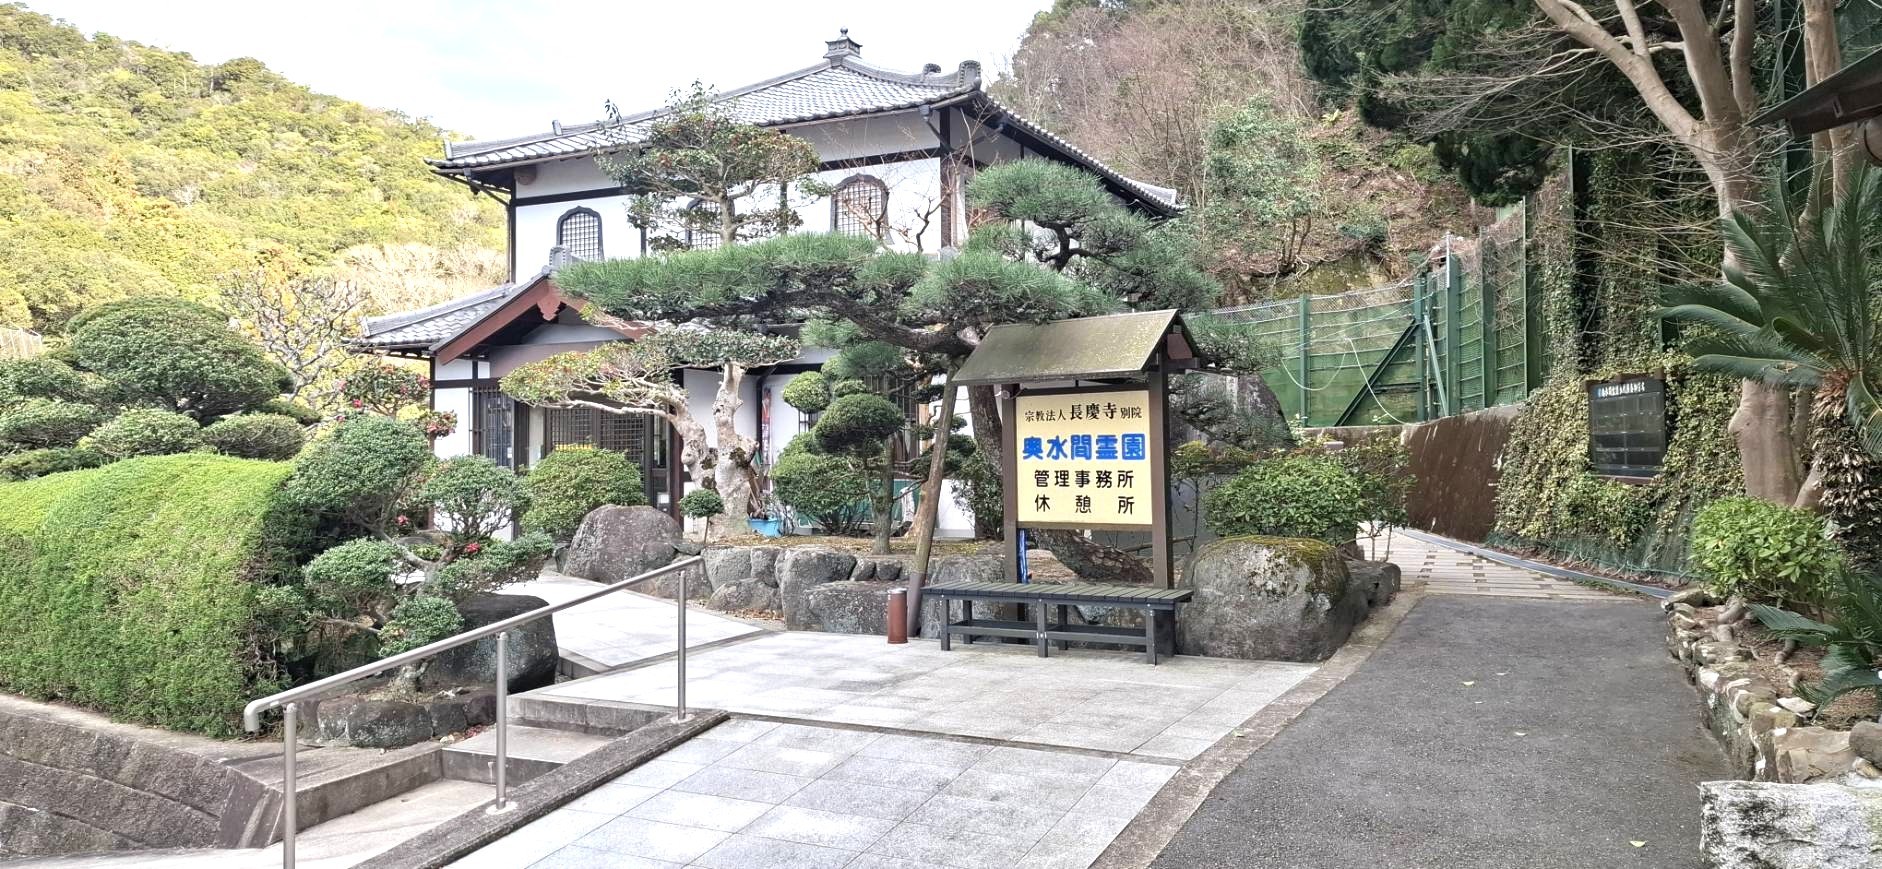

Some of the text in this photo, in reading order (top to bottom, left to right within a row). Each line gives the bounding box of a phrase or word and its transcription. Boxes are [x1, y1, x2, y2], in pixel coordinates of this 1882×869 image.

[1024, 402, 1143, 422] 宗教法人長慶寺別院
[1022, 433, 1146, 461] 奥水間霊園
[1034, 470, 1135, 489] 管理事務所
[1035, 494, 1135, 515] 休憩所
